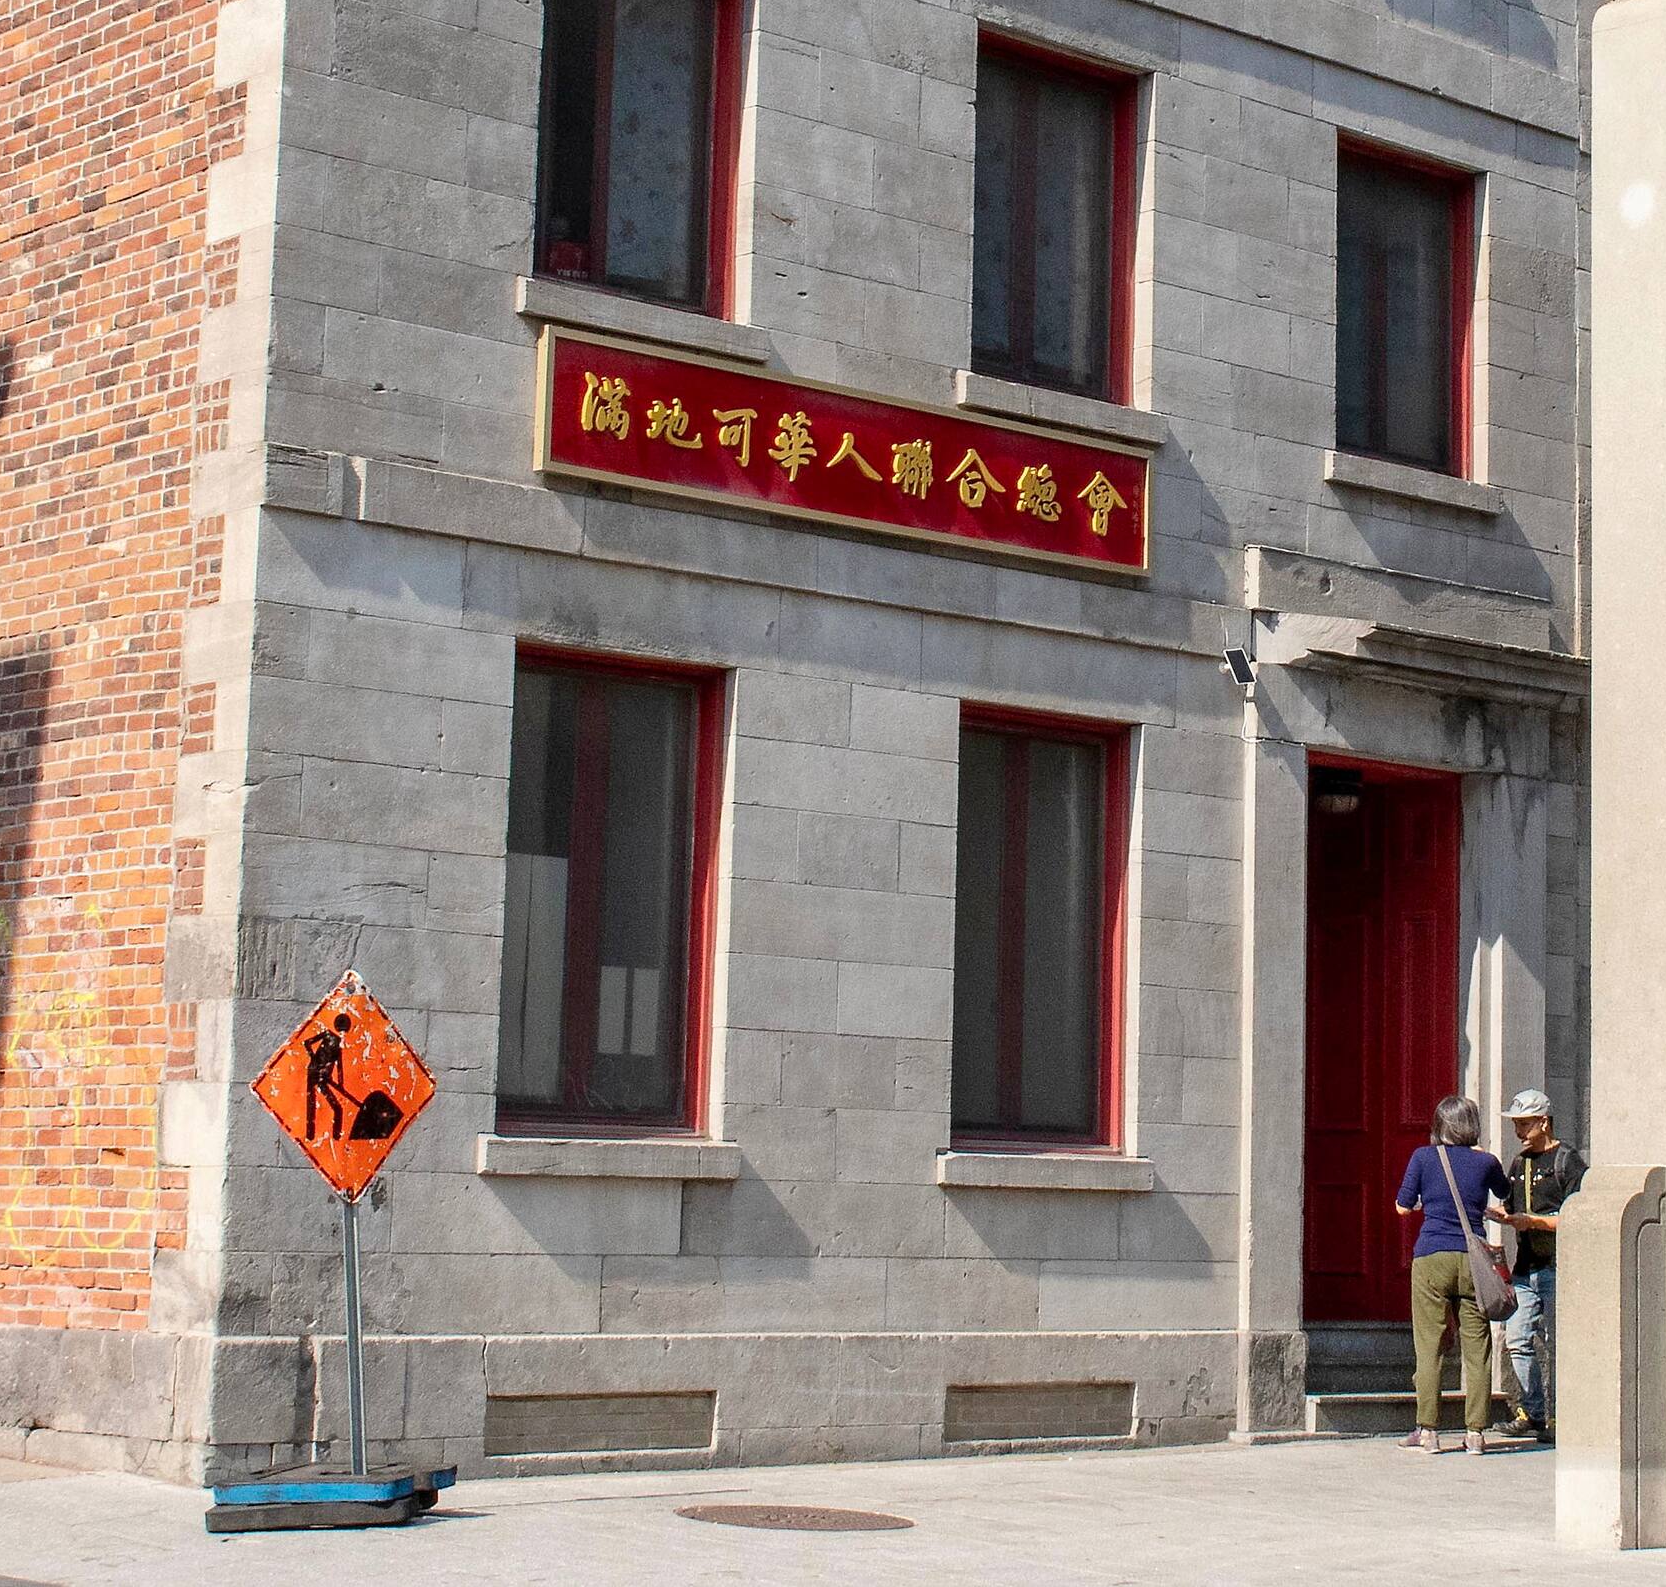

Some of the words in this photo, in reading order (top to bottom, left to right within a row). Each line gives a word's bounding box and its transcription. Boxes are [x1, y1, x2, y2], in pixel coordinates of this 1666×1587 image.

[580, 370, 1129, 537] 滿地可華人聯合總會
